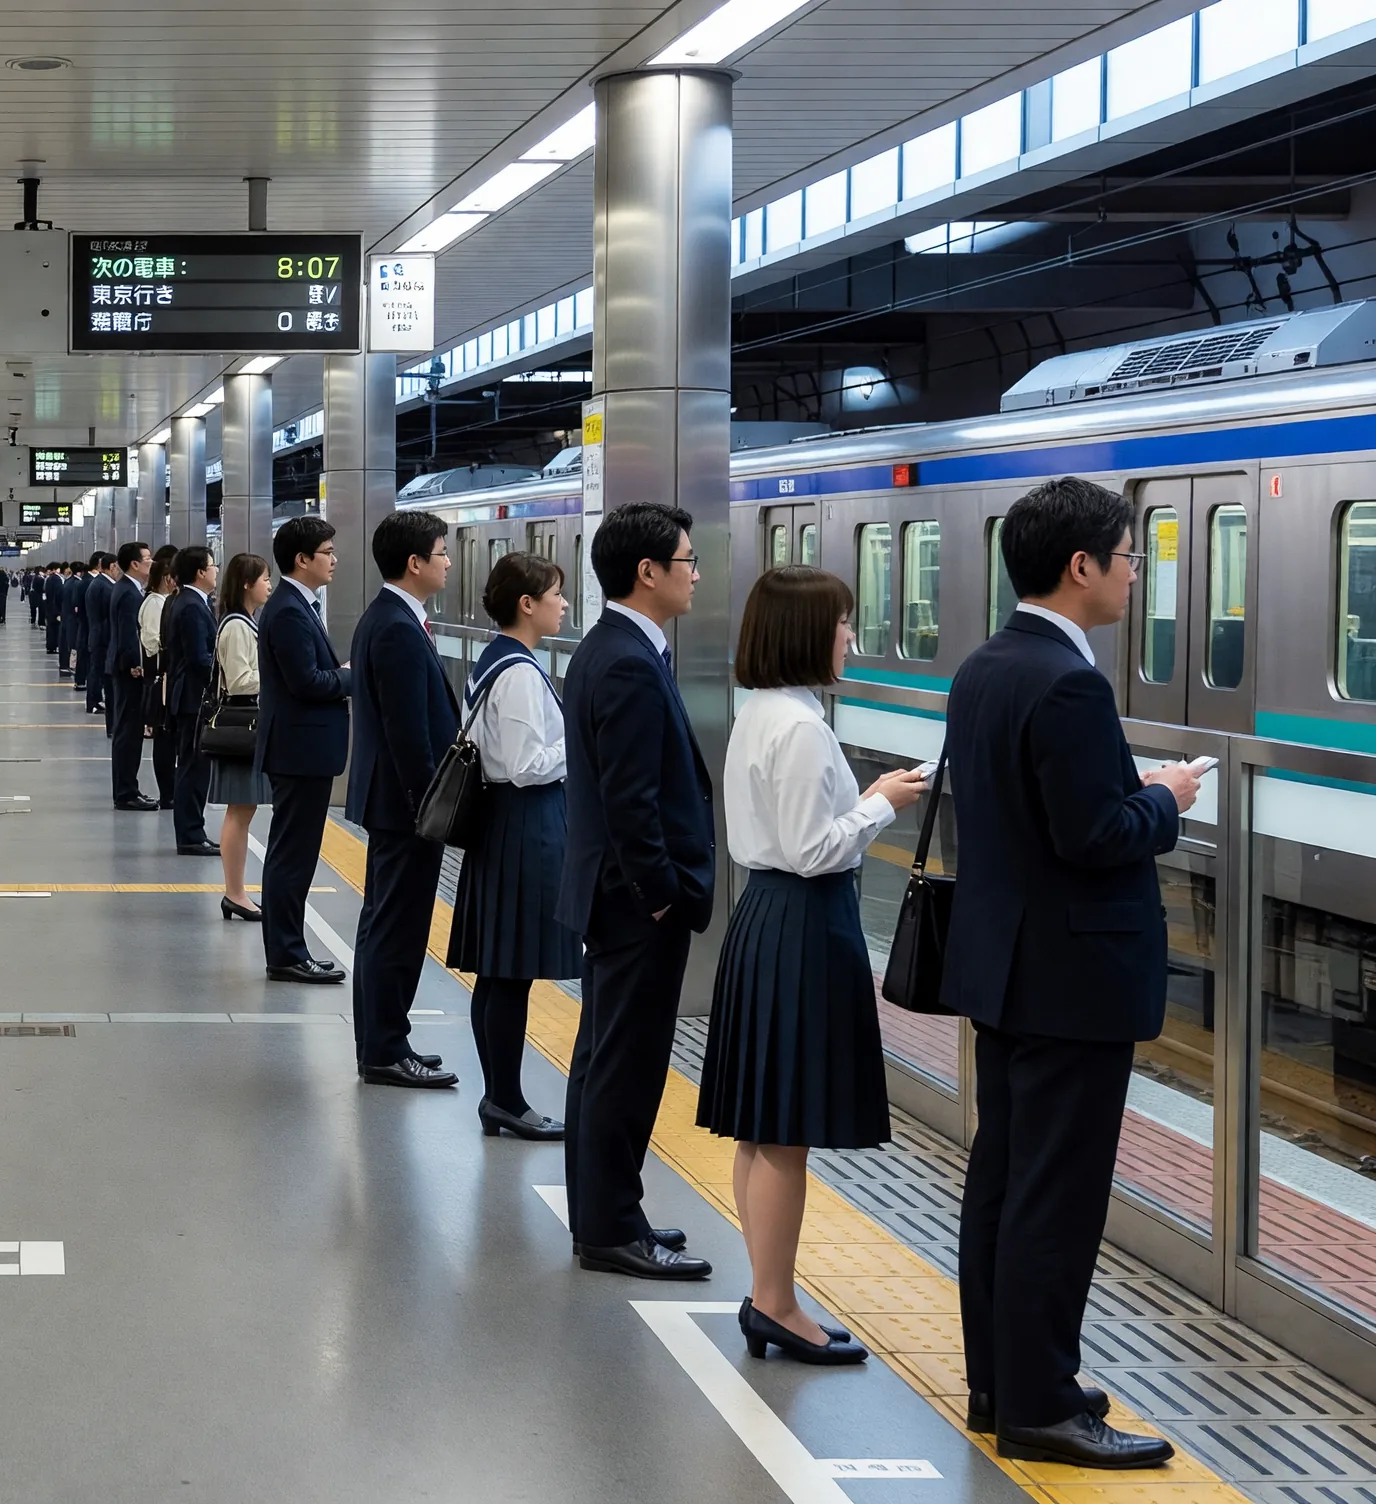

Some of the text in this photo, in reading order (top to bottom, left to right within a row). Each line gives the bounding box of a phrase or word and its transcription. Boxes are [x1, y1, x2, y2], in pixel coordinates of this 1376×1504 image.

[277, 256, 340, 279] 8:07
[91, 283, 174, 306] 東京行き
